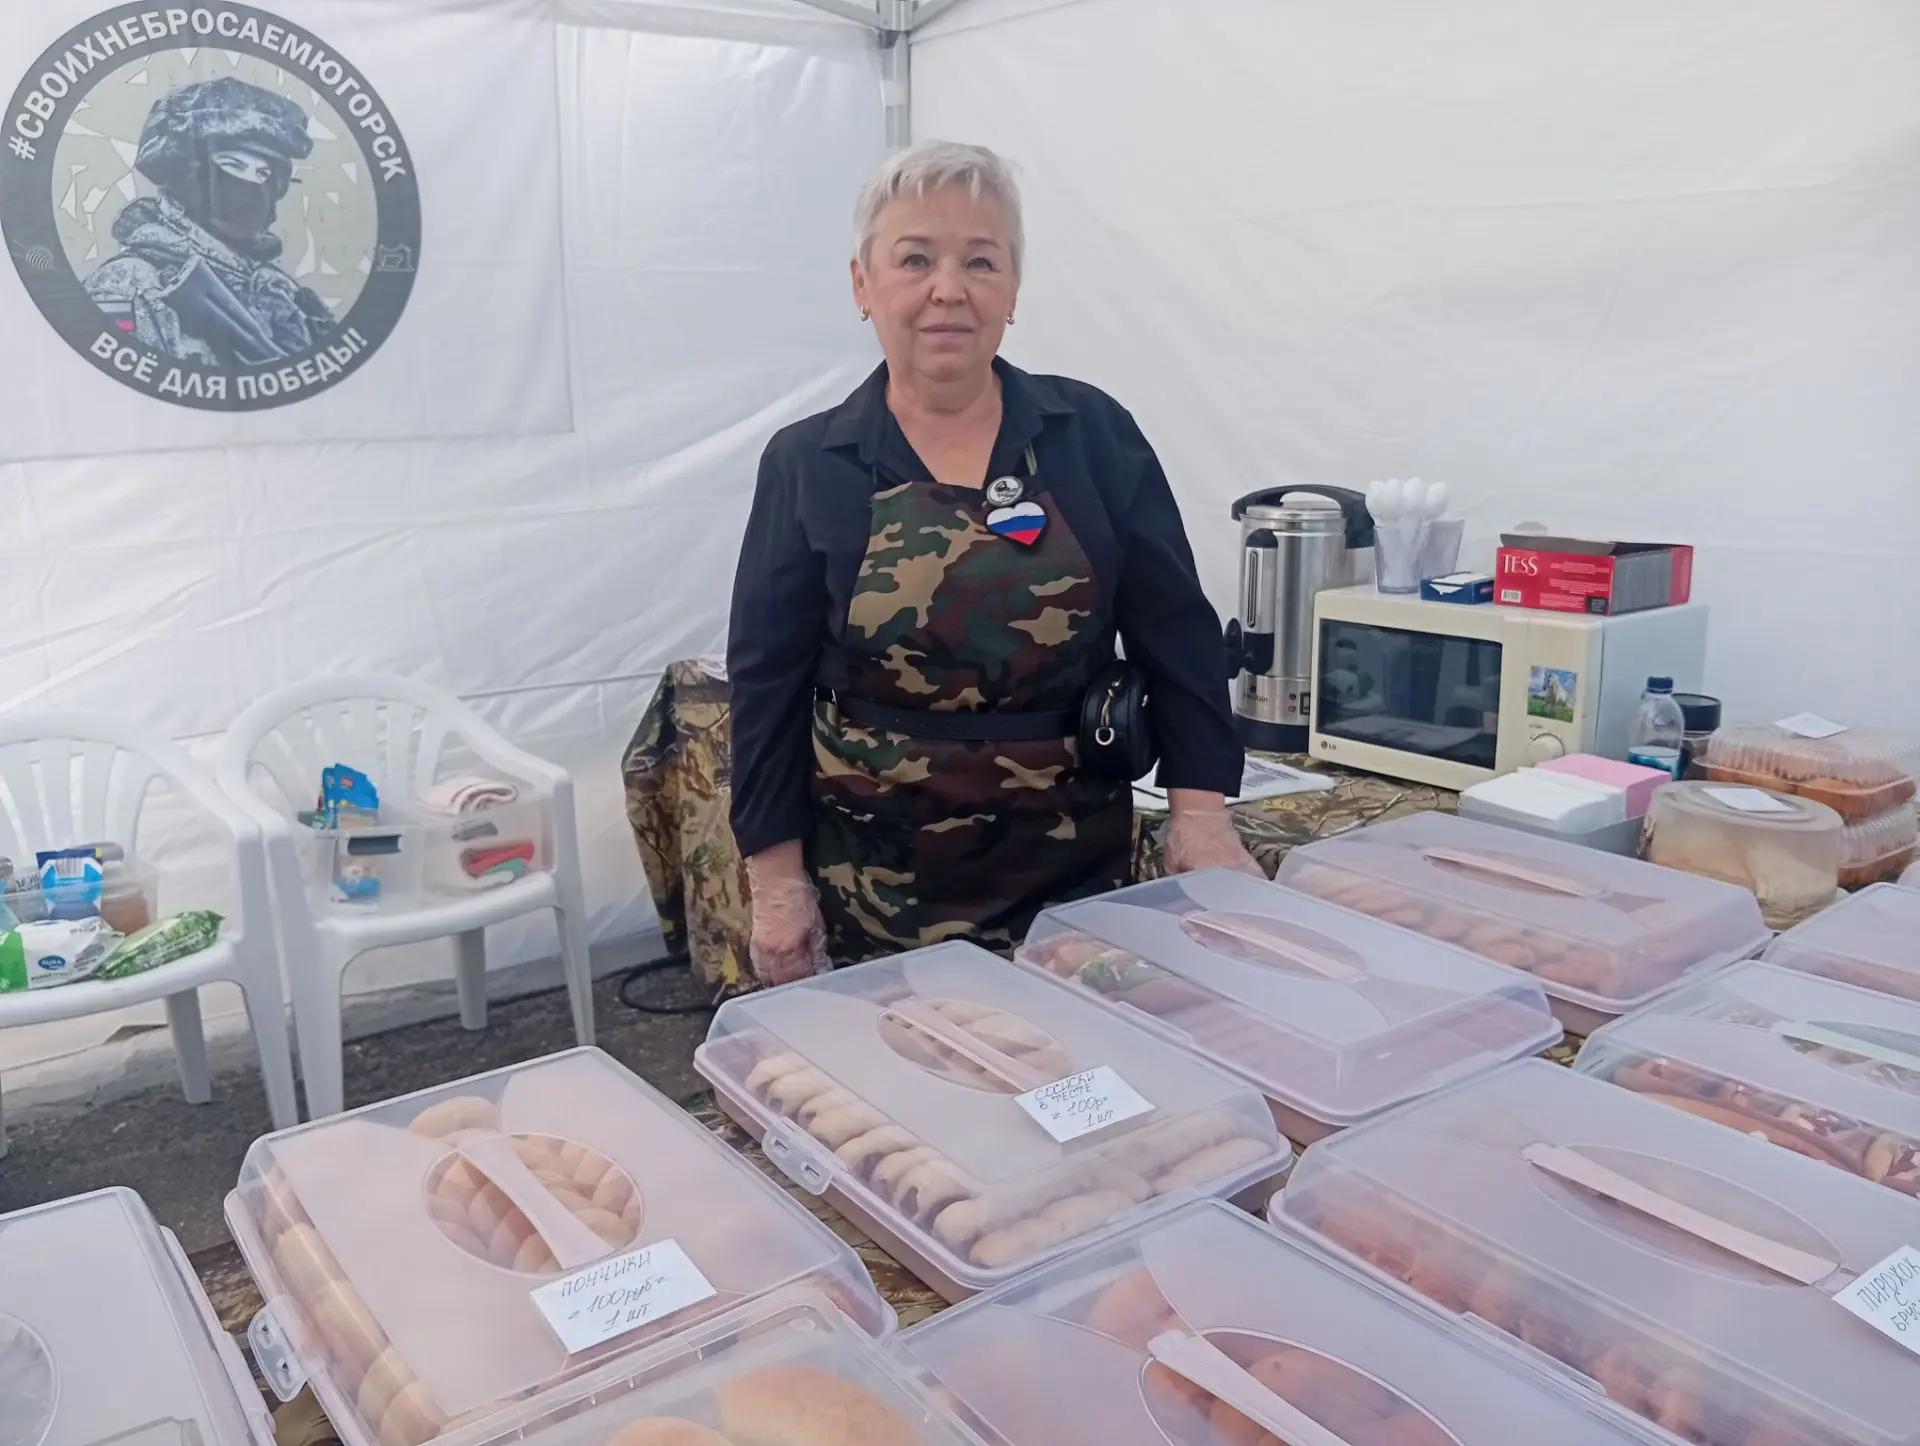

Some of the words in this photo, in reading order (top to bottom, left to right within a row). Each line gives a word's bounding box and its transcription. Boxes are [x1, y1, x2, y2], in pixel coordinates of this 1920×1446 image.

[8, 8, 407, 182] #СВОИХНЕБРОСАЕМЮГОРСК
[90, 331, 159, 384] ВСЁ
[159, 367, 227, 400] ДЛЯ
[236, 327, 369, 400] ПОБЕДЫ!
[1501, 553, 1538, 577] TESS
[561, 1250, 651, 1297] ПОНЧИКИ
[1890, 1299, 1920, 1332] БРУС
